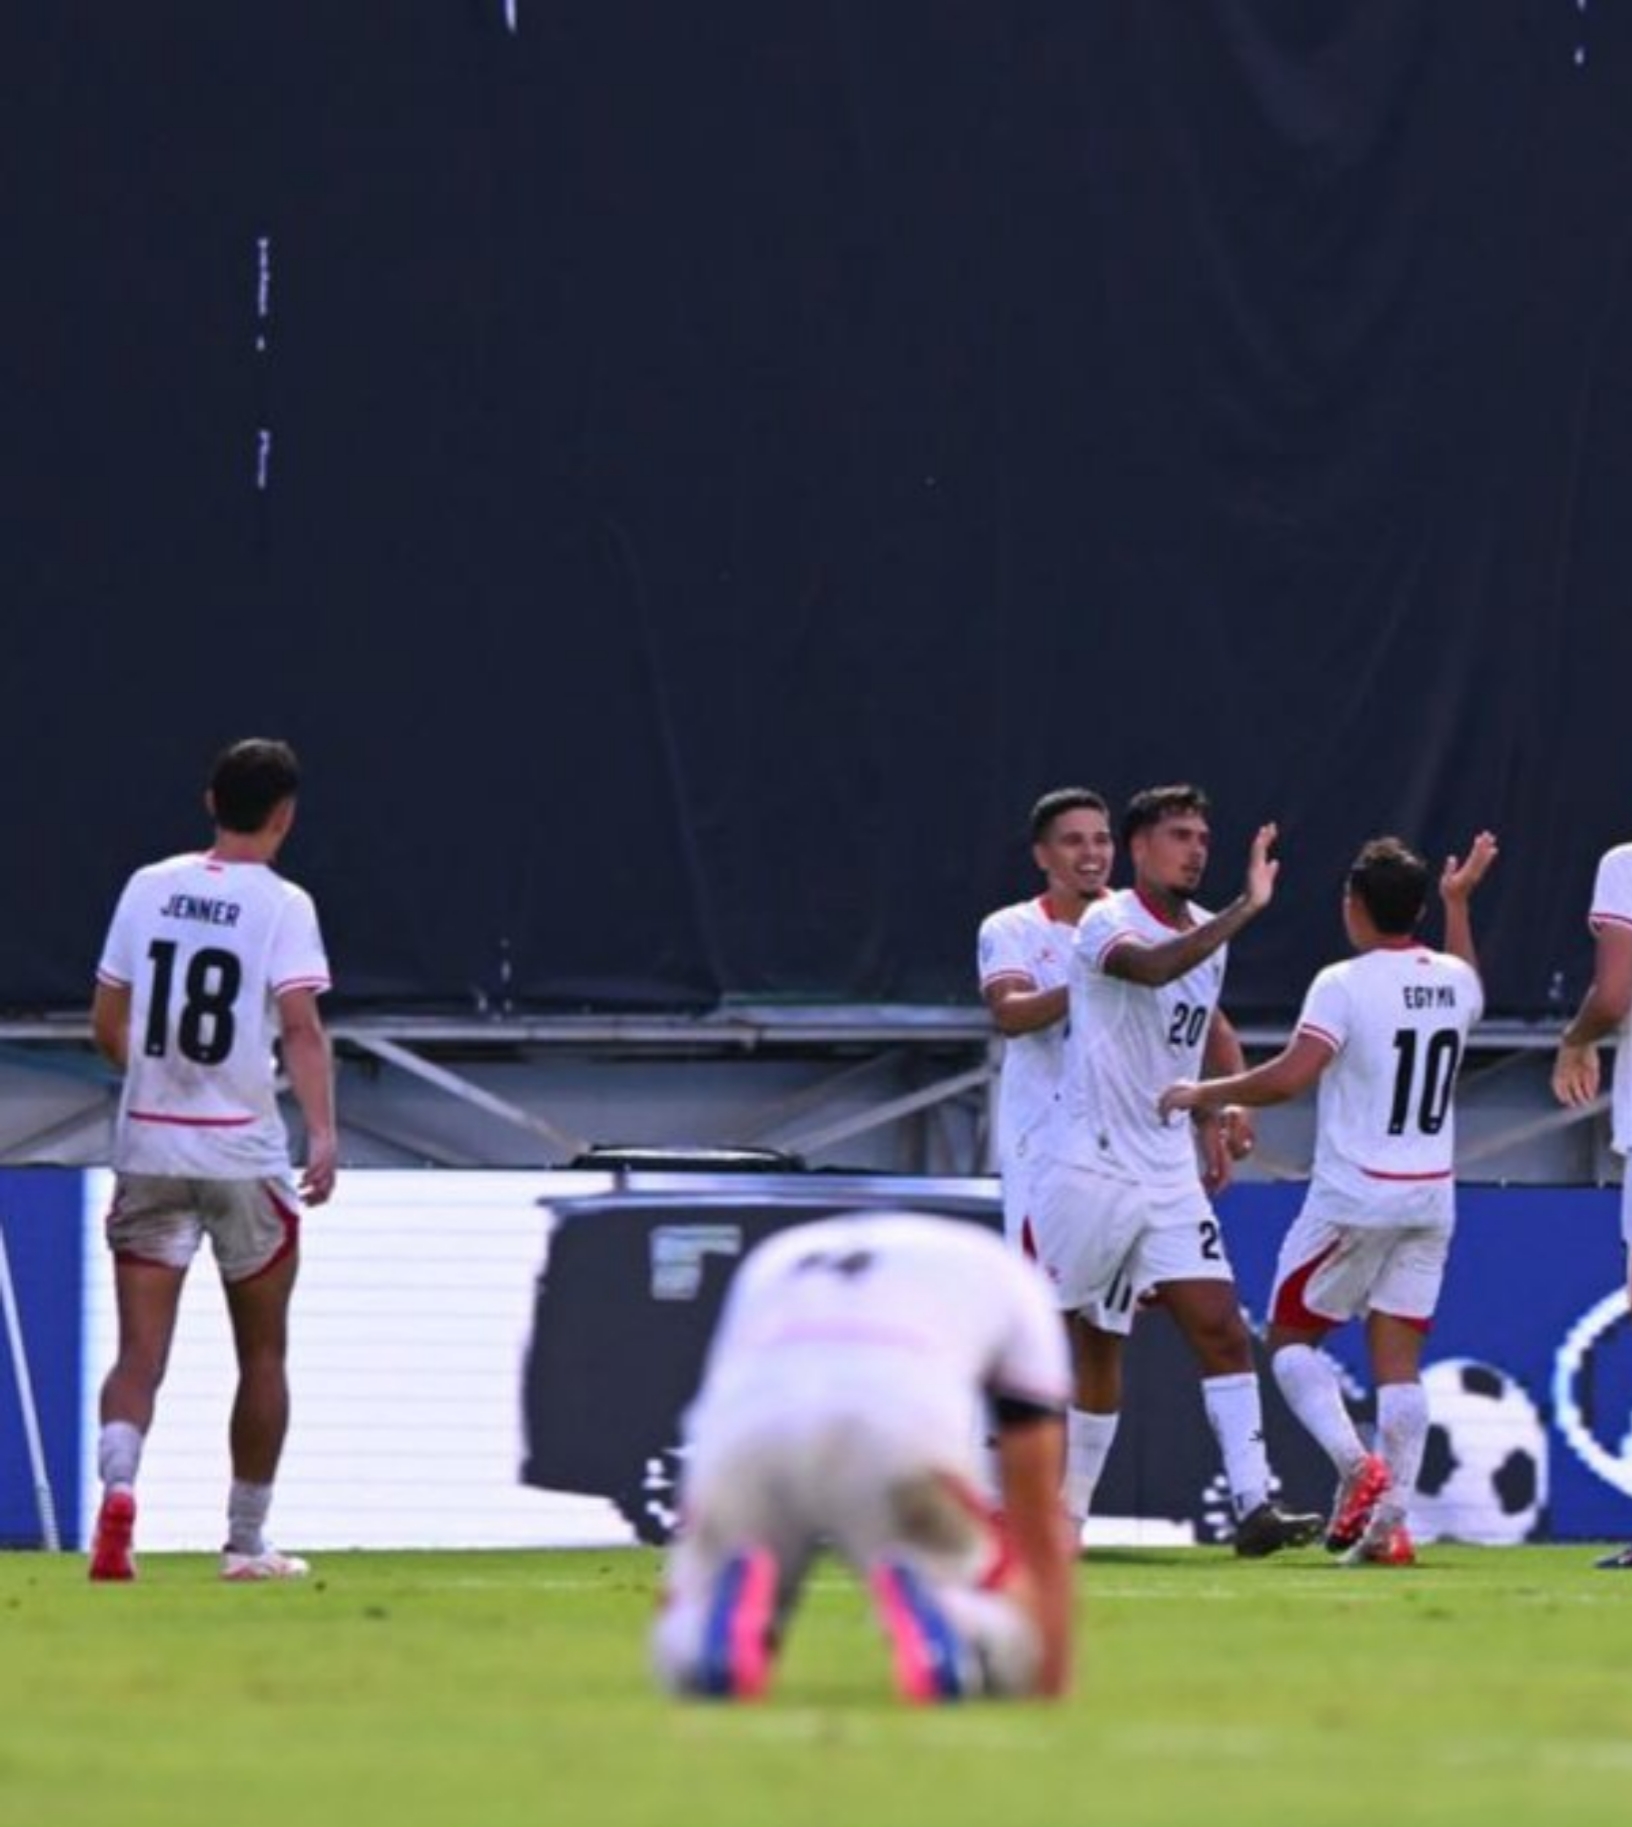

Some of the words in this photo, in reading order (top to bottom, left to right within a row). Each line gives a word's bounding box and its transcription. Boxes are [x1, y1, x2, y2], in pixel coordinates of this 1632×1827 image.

[159, 893, 241, 929] JENNER
[143, 940, 242, 1066] 18
[1403, 985, 1434, 1009] EGY
[1168, 1002, 1208, 1047] 20
[1387, 1027, 1461, 1136] 10
